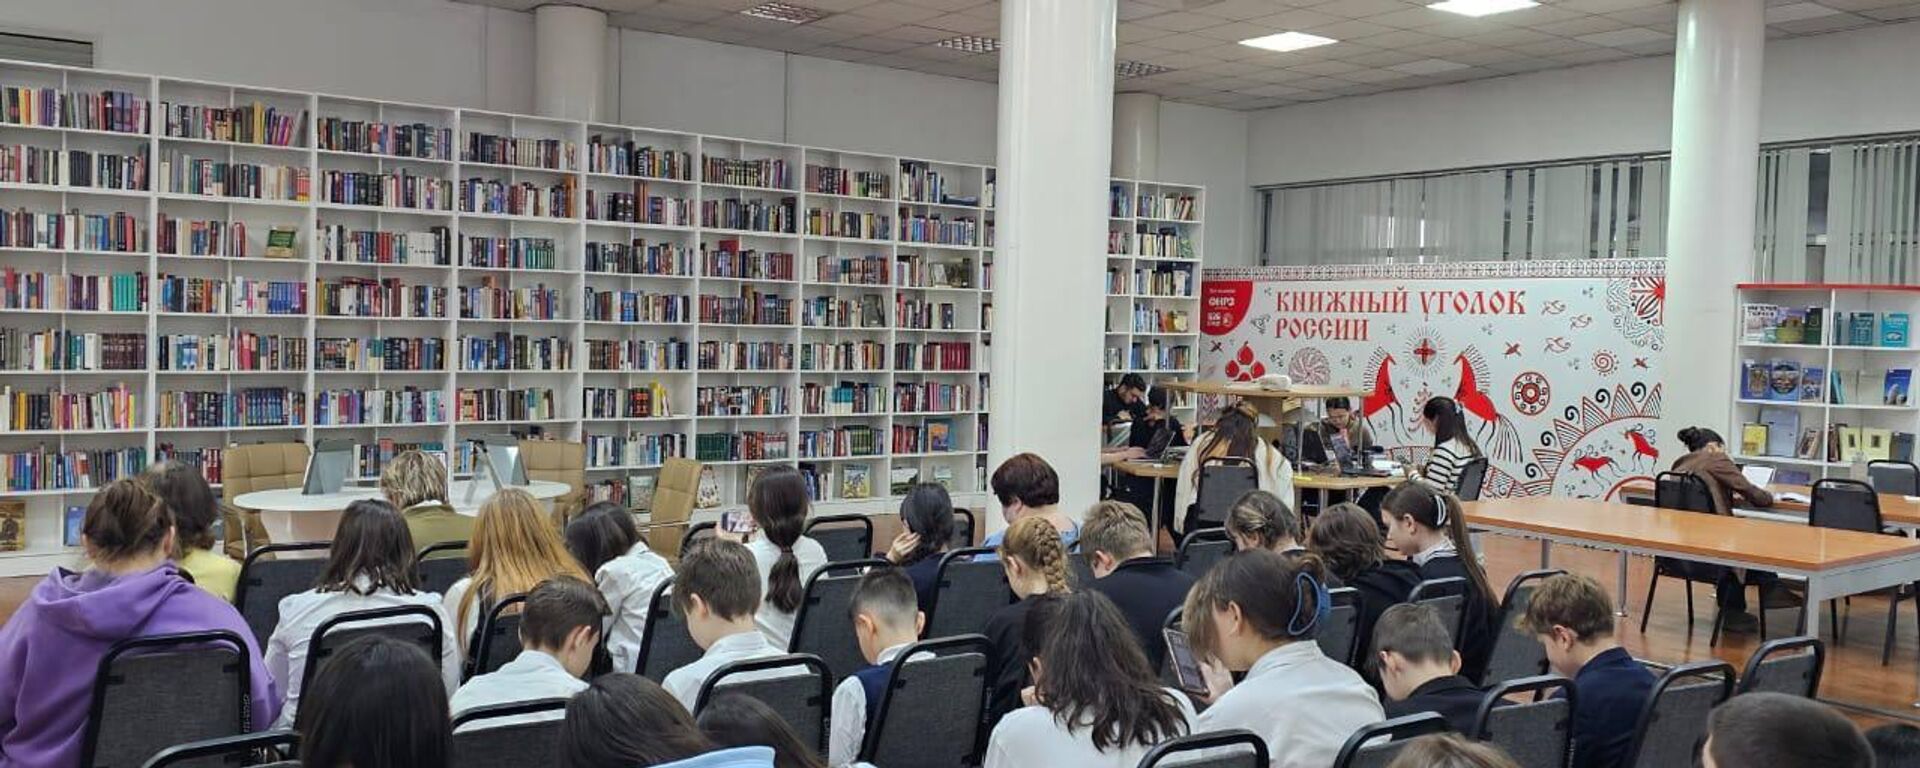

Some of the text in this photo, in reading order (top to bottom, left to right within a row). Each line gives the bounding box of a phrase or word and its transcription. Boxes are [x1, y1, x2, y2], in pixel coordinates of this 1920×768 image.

[1276, 286, 1526, 321] КНИЖНЫЙ УГОЛОК
[1275, 318, 1368, 341] РОССИИ
